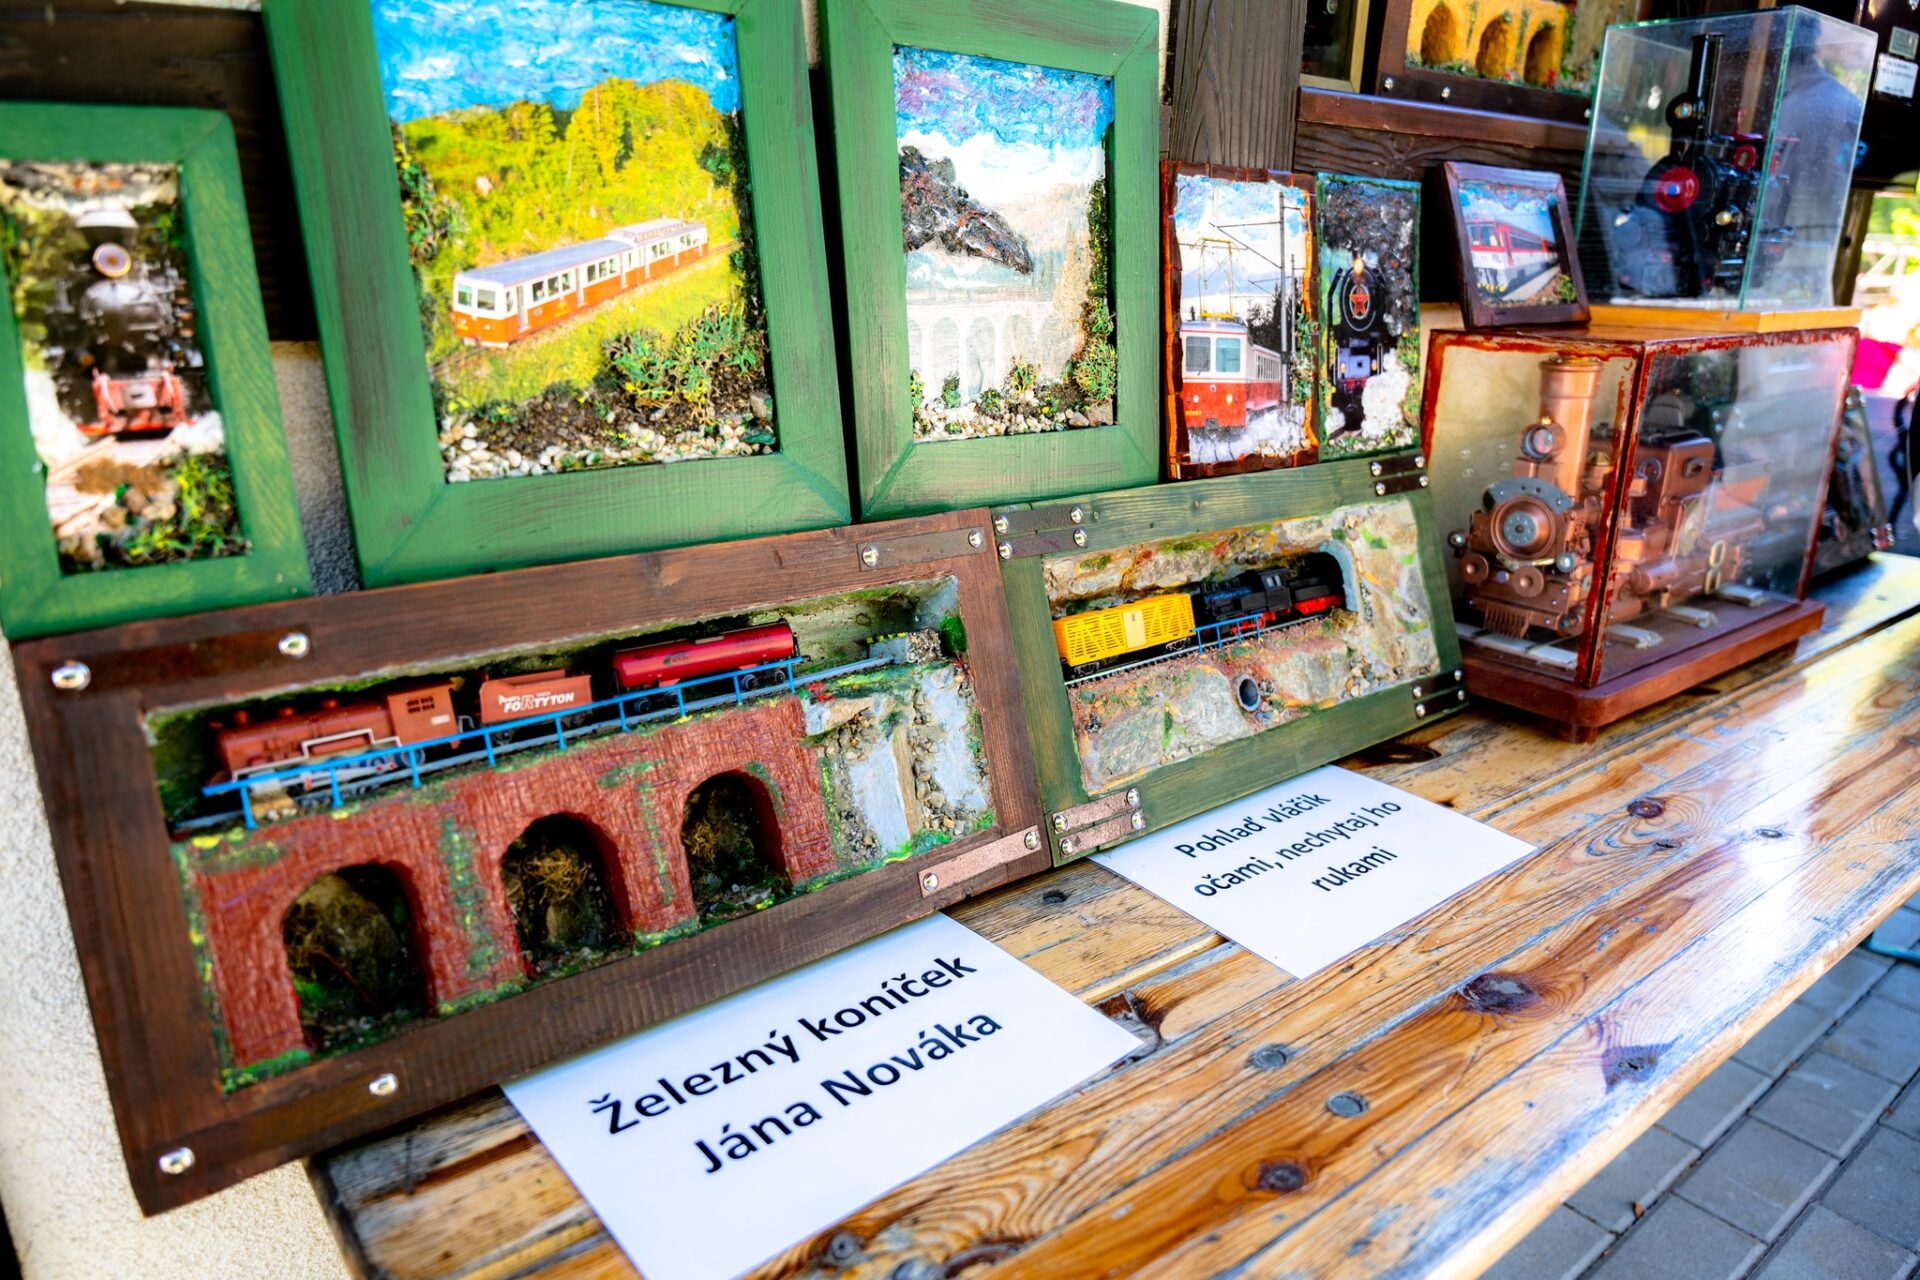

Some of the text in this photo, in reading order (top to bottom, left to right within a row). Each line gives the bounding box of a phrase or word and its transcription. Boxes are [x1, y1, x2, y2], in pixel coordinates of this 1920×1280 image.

[1174, 792, 1331, 858] Pohlaď vláčik
[1194, 801, 1402, 897] očami, nechytaj ho
[1311, 846, 1398, 892] rukami
[588, 954, 977, 1135] Železný koníček
[693, 1010, 1003, 1174] Jána Nováka
